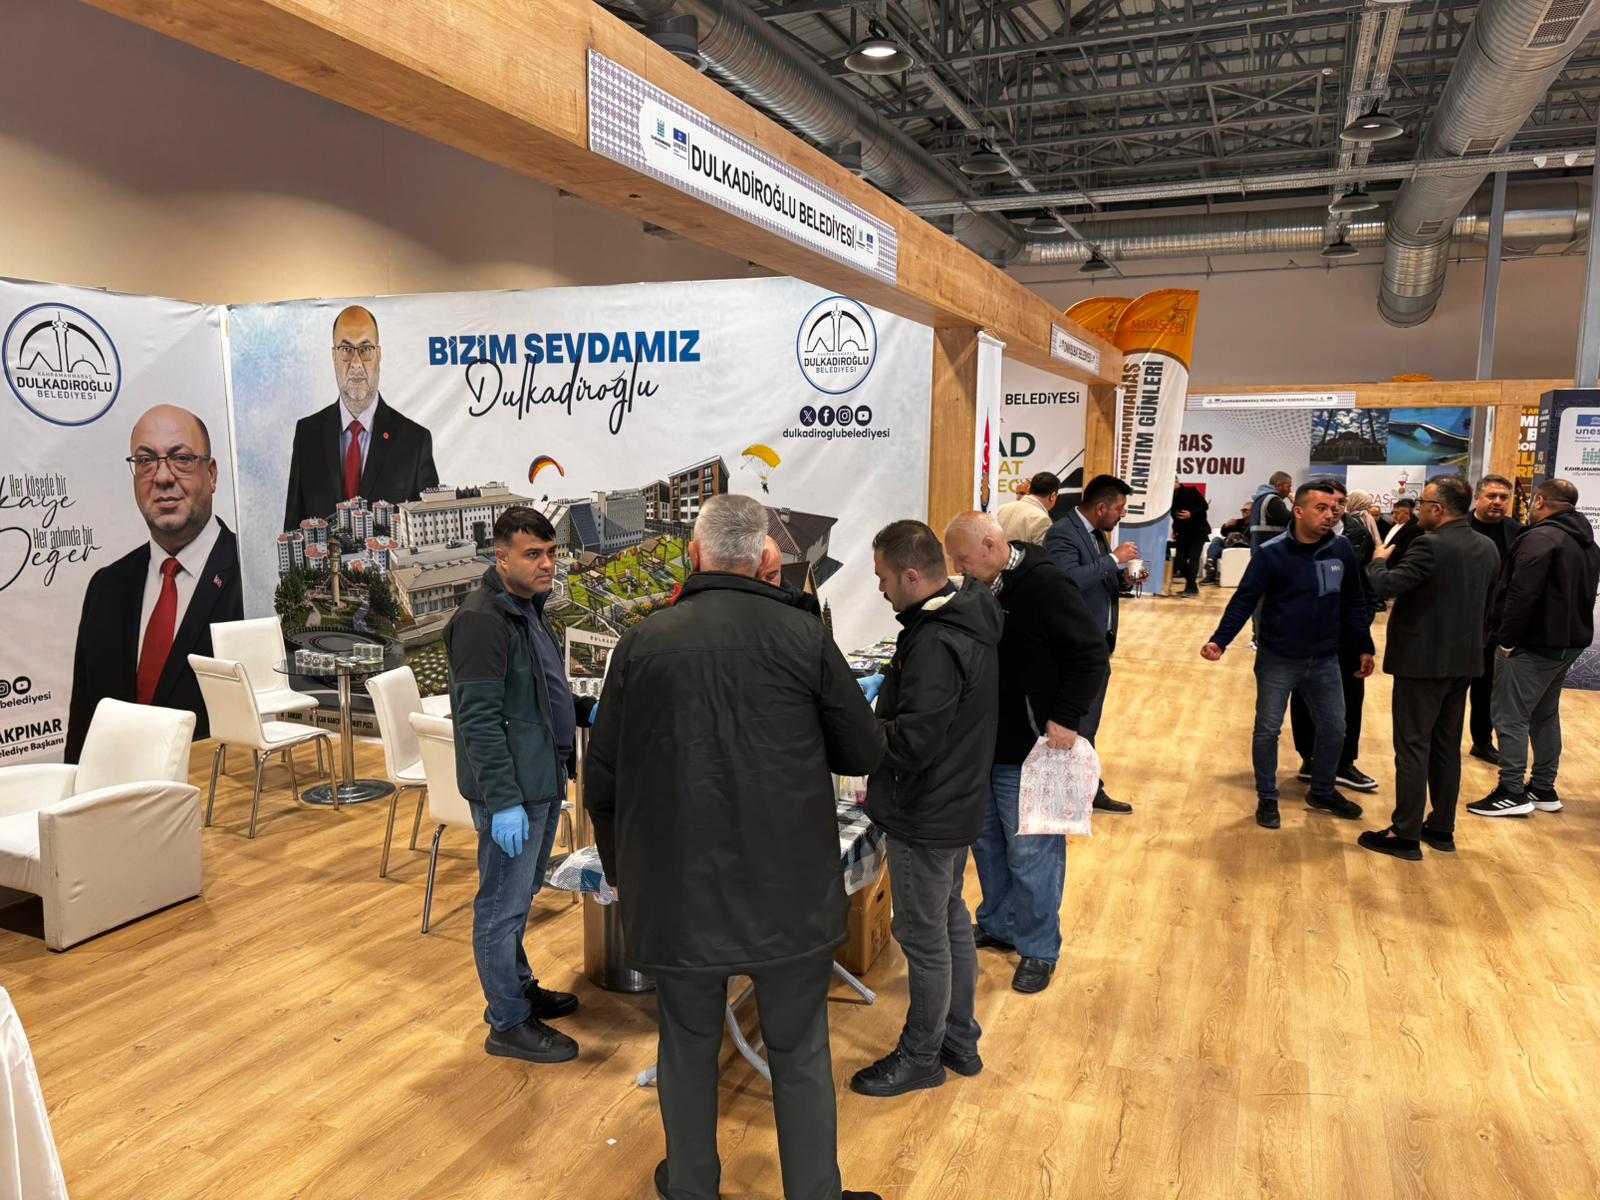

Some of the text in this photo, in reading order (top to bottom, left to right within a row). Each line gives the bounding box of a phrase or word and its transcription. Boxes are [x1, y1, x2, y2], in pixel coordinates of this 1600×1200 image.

[691, 144, 855, 249] DULKADİROĞLU BELEDİYESİ
[428, 330, 701, 366] BİZİM SEVDAMIZ
[465, 343, 659, 435] Dulkadiroğlu
[1136, 361, 1164, 427] GÜNLERİ
[782, 428, 890, 440] dulkadiroglubelediyesi
[1130, 432, 1154, 495] TANITIM
[9, 472, 67, 499] Her köşede bir
[33, 527, 48, 549] Her
[82, 524, 94, 545] bir
[31, 738, 65, 751] Başkanı
